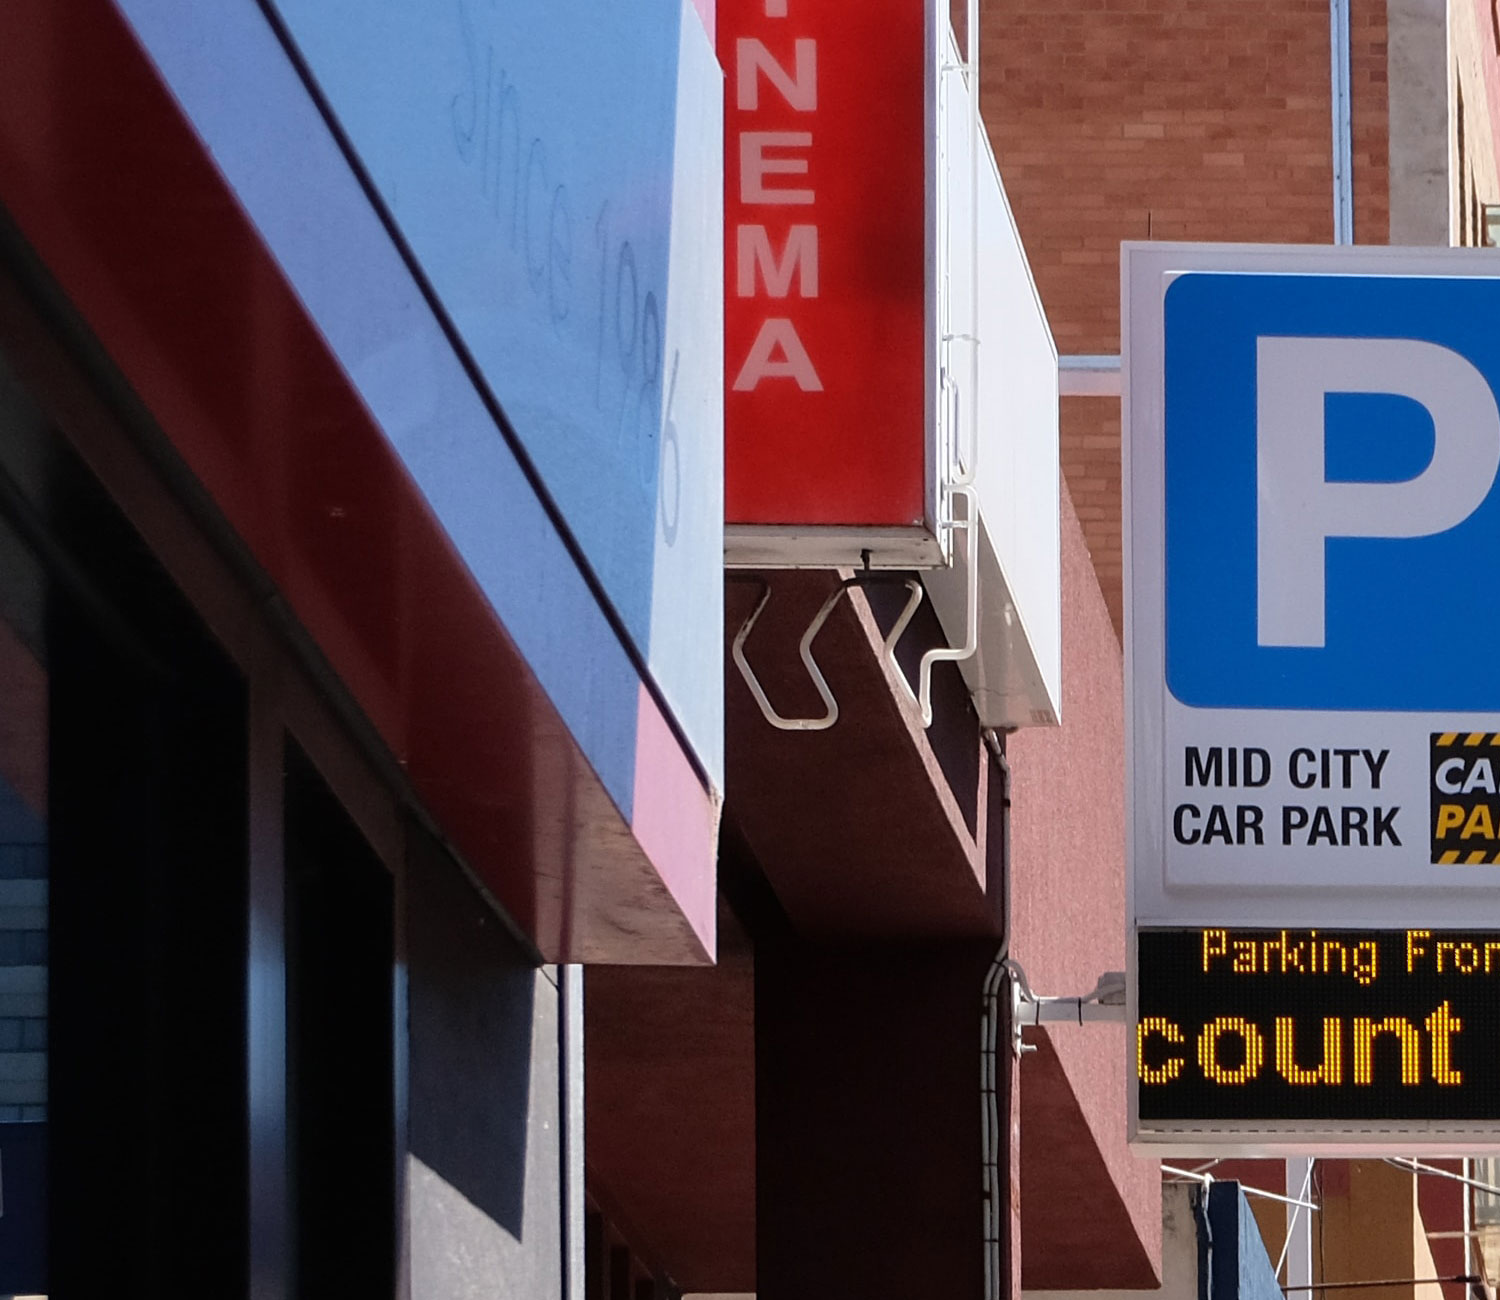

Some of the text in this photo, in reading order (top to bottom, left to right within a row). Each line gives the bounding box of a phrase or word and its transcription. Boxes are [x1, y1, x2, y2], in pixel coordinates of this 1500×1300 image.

[734, 0, 824, 392] NEMA
[1184, 747, 1390, 790] MID CITY
[1172, 805, 1402, 847] CAR PARK
[1201, 930, 1379, 984] Parking
